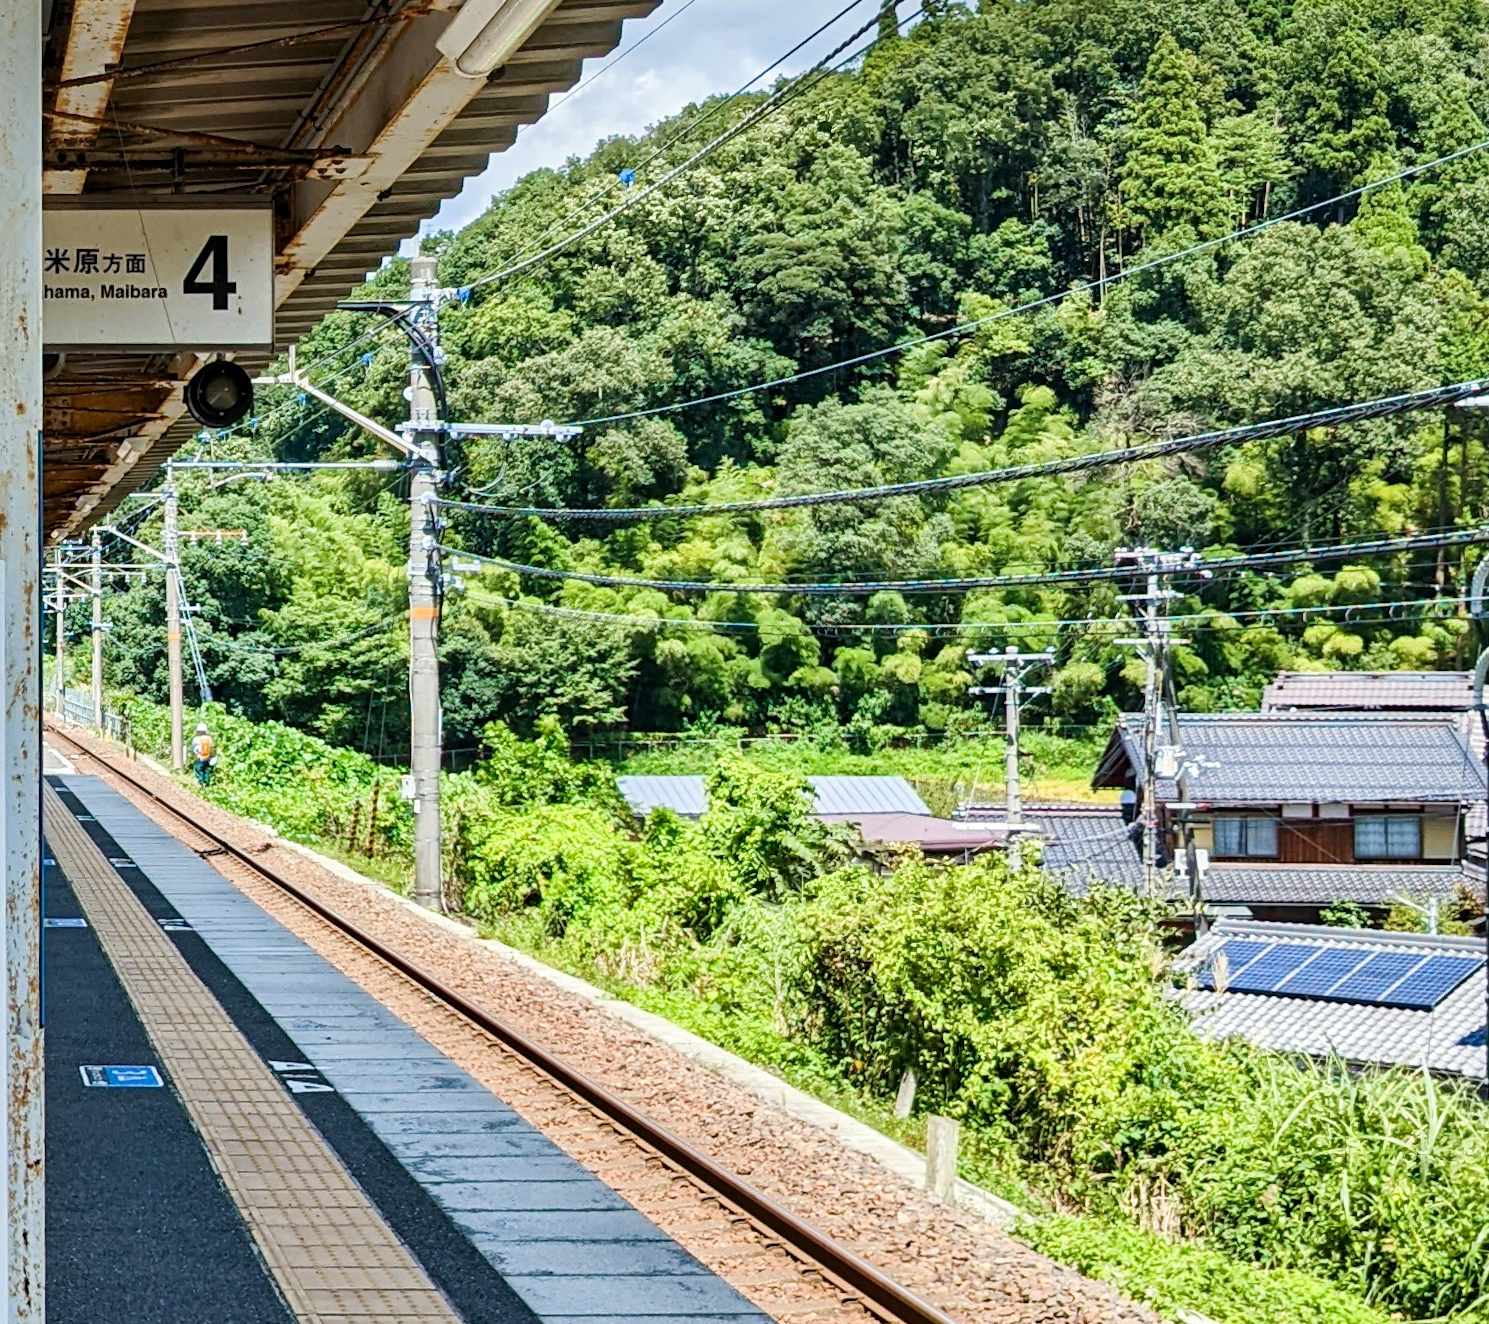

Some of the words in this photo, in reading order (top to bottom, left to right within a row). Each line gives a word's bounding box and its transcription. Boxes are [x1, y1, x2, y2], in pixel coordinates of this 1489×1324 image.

[44, 249, 145, 274] 米原方面
[182, 235, 237, 310] 4
[101, 285, 167, 298] Maibara
